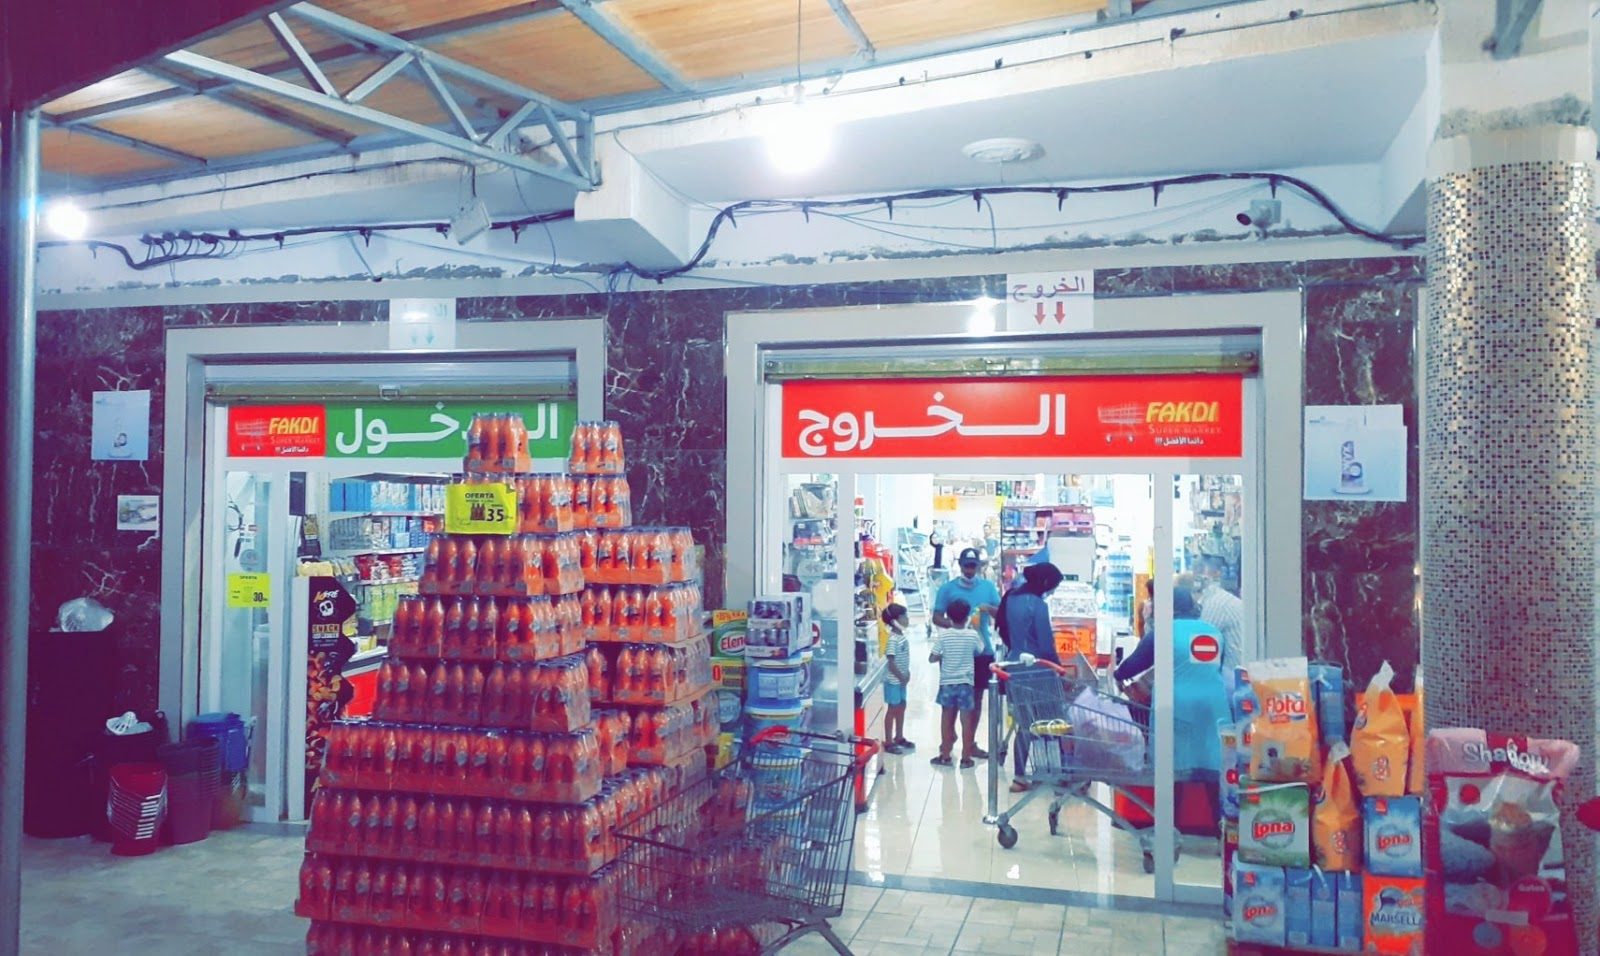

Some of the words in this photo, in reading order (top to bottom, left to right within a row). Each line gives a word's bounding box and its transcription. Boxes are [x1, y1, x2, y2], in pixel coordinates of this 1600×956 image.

[1013, 276, 1085, 302] الخروج
[1145, 401, 1219, 423] FAKDI
[268, 416, 319, 435] FAKDI
[798, 391, 1066, 456] الخروج
[486, 508, 504, 522] 35
[721, 636, 746, 650] Elen
